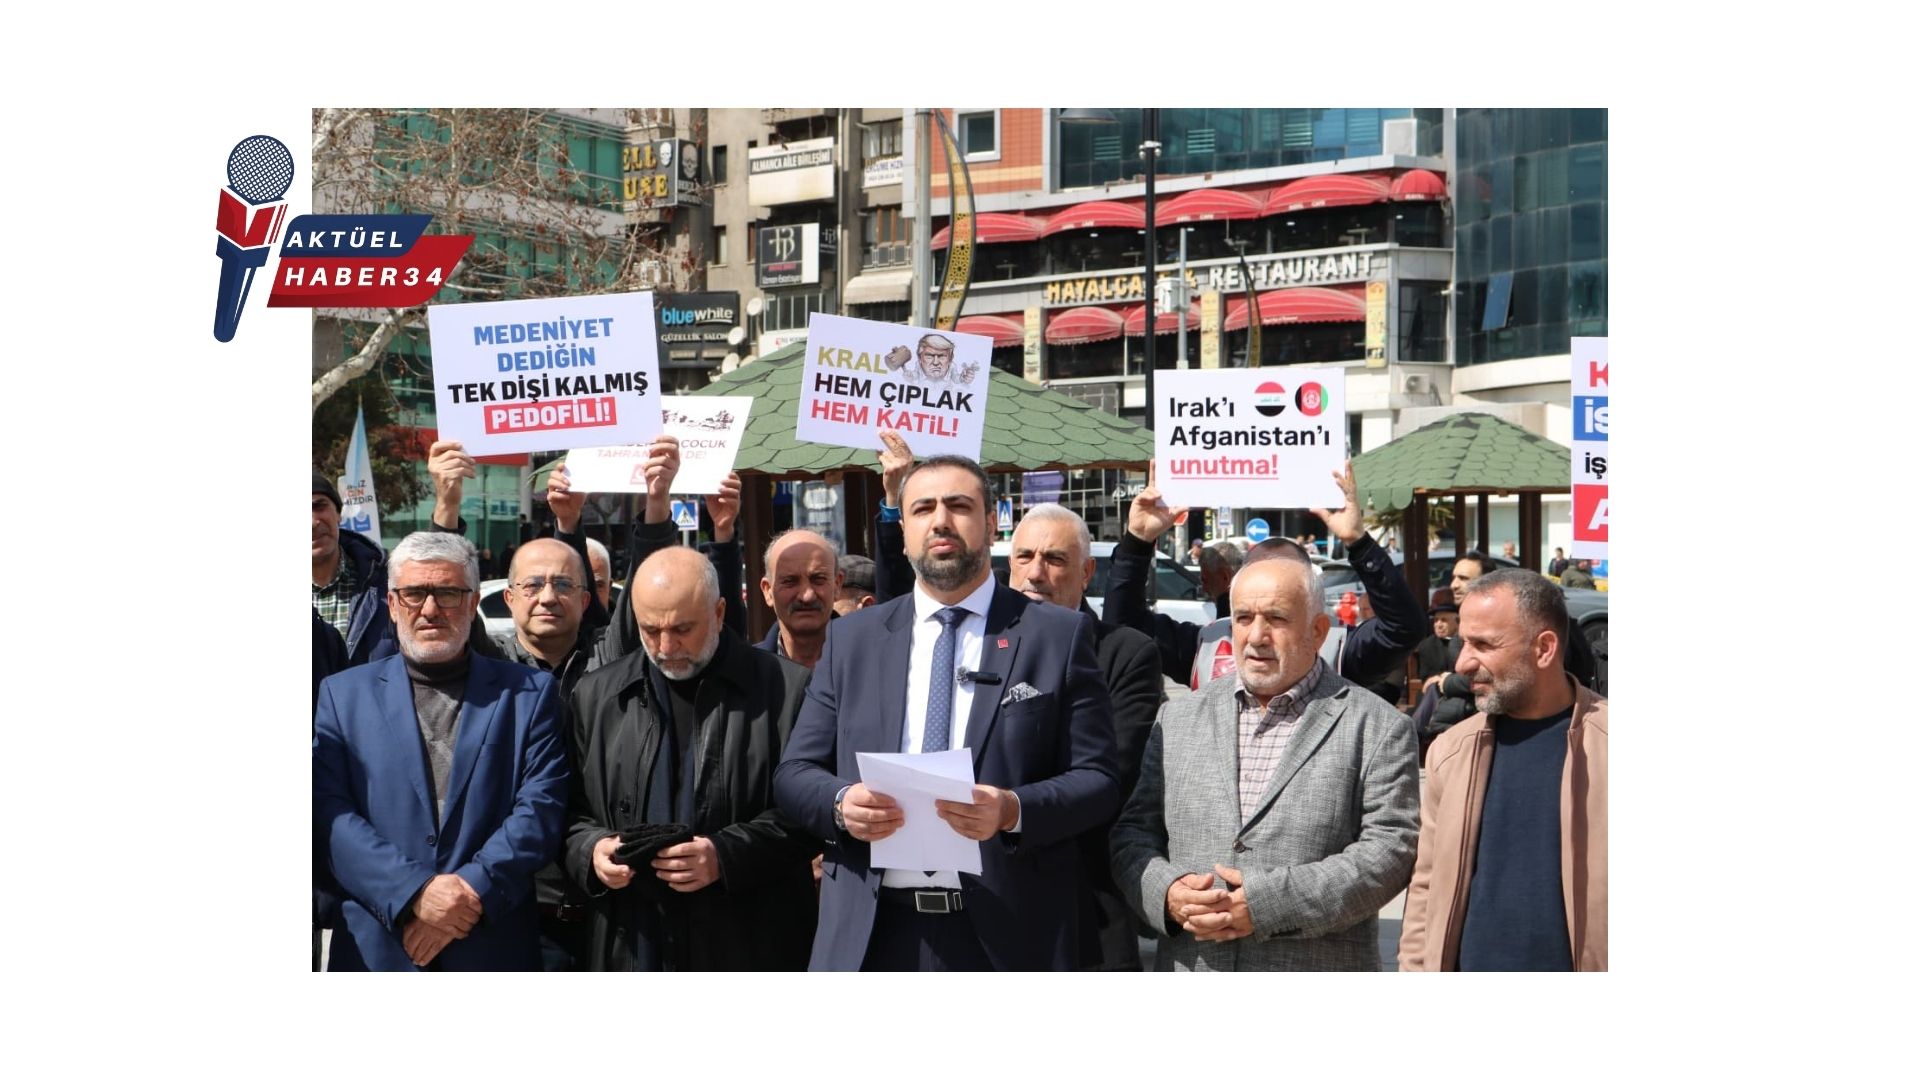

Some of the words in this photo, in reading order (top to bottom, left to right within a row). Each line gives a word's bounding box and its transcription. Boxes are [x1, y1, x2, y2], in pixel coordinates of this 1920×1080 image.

[752, 159, 782, 173] ALMANCA
[783, 154, 797, 168] AİLE
[662, 307, 733, 325] bluewhite
[474, 316, 614, 346] MEDENİYET
[497, 343, 596, 373] DEDİĞİN
[817, 346, 888, 375] KRAL
[447, 382, 497, 404] TEK
[501, 373, 550, 404] DİŞİ
[555, 371, 649, 397] KALMIŞ
[815, 372, 871, 399] HEM
[879, 382, 974, 413] ÇIPLAK
[491, 400, 611, 430] PEDOFİLİ!
[811, 399, 869, 426] HEM
[1169, 397, 1235, 418] Irak'ı
[1169, 425, 1330, 450] Afganistan'ı
[1170, 454, 1278, 475] unutma!
